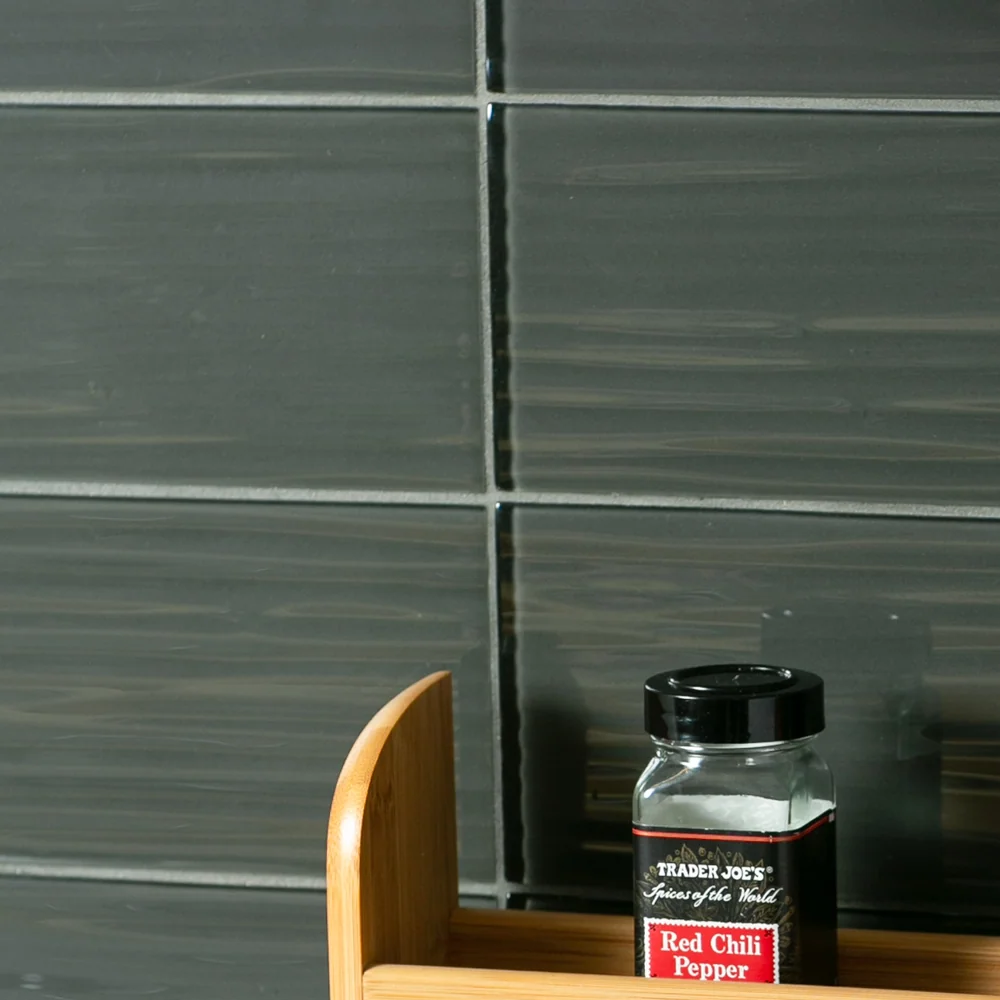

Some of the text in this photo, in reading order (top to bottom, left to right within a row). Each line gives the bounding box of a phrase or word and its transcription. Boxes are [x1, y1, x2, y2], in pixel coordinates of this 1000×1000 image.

[656, 862, 719, 880] TRADER
[643, 882, 784, 907] Spices of the World
[660, 930, 762, 956] Red Chili
[673, 955, 749, 981] Pepper
